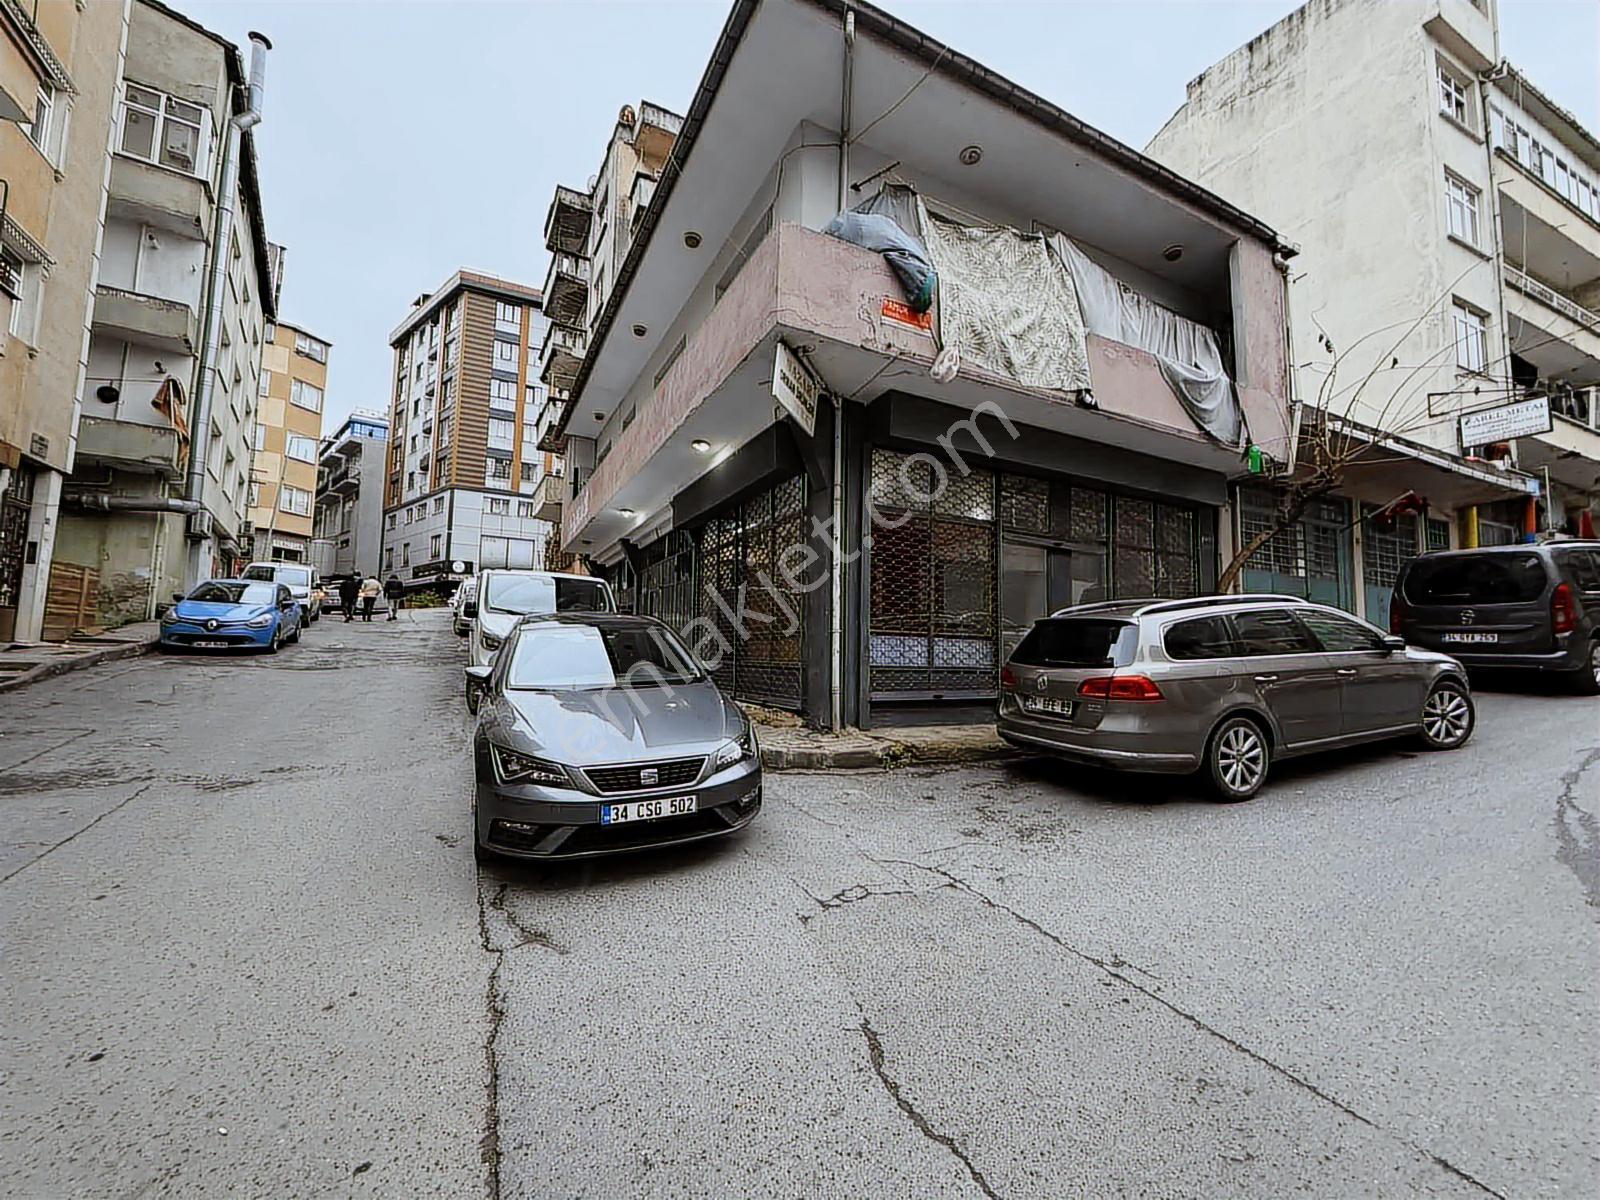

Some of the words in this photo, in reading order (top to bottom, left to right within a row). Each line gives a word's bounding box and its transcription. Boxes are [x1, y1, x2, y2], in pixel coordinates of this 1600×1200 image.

[612, 805, 628, 821] 34
[637, 802, 662, 818] CSG
[670, 797, 694, 814] 502
